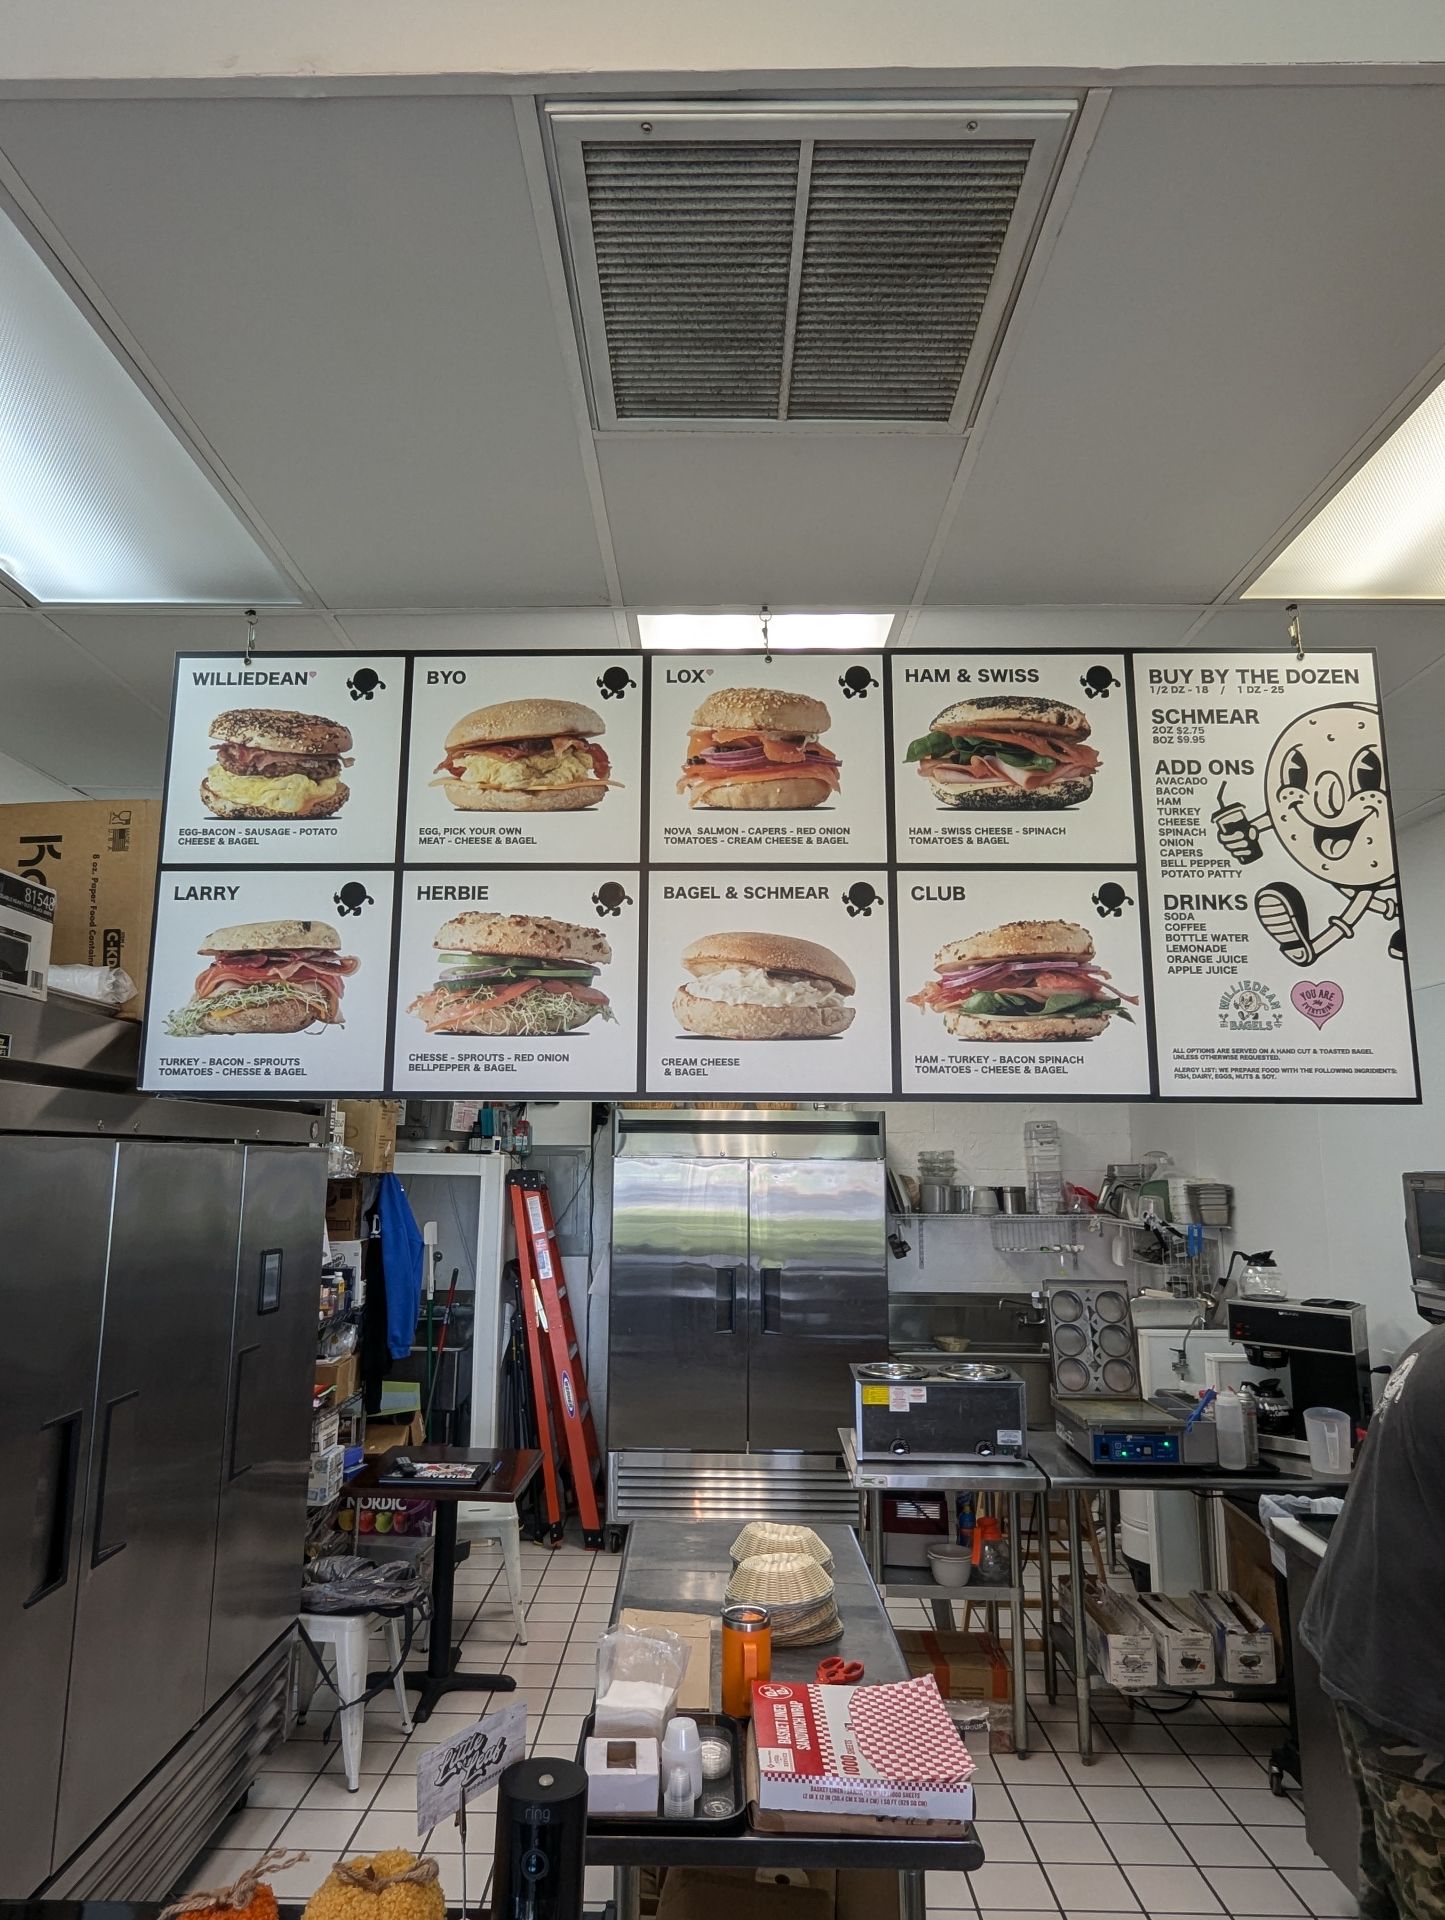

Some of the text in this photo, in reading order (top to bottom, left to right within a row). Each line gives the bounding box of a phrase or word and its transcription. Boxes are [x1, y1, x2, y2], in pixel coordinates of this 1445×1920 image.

[192, 672, 308, 686] WILLIEDEAN
[427, 670, 466, 684] BYO
[666, 669, 705, 684] LOX
[905, 668, 1040, 683] HAM & SWISS
[1148, 668, 1360, 684] BUY BY THE DOZEN
[1150, 685, 1285, 695] 1/2 DZ 18 1 DZ 25
[1151, 708, 1260, 724] SCHMEAR
[1176, 726, 1205, 735] $2.75
[1176, 736, 1205, 744] $9.95
[1155, 759, 1255, 776] ADD ONS
[1155, 776, 1208, 785] AVACADO
[1156, 786, 1194, 795] BACON
[1156, 797, 1182, 806] HAM
[1156, 807, 1201, 816] TURKEY
[1158, 818, 1200, 826] CHEESE
[244, 828, 291, 836] SAUSAGE
[299, 828, 338, 836] POTATO
[443, 827, 466, 836] PICK
[468, 827, 496, 836] YOUR
[498, 827, 522, 836] OWN
[664, 827, 851, 835] NOVA SALMON CAPERS RED ONION
[908, 827, 1066, 835] HAM SWISS CHEESE SPINACH
[1158, 828, 1207, 836] SPINACH
[178, 837, 260, 846] CHEESE BAGEL
[418, 836, 537, 845] MEAT CHEESE BAGEL
[663, 836, 849, 845] TOMATOES CREAM CHEESE BAGEL
[908, 836, 1010, 845] TOMATOES BAGEL
[1159, 838, 1194, 847] ONION
[1160, 848, 1204, 858] CAPERS
[1160, 859, 1231, 868] BELL PEPPER
[1161, 869, 1243, 878] POTATO PATTY
[90, 877, 99, 903] Paper
[174, 886, 240, 900] LARRY
[417, 886, 489, 900] HERBIE
[664, 886, 830, 899] BAGEL & SCHMEAR
[911, 886, 966, 902] CLUB
[1163, 894, 1248, 911] DRINKS
[89, 905, 98, 926] Food
[1164, 912, 1195, 921] SODA
[1164, 922, 1207, 932] COFFEE
[1165, 934, 1249, 942] BOTTLE WATER
[1166, 944, 1228, 953] LEMONADE
[1166, 954, 1248, 964] ORANGE JUICE
[1167, 966, 1238, 975] APPLE JUICE
[1300, 989, 1335, 1002] YOU ARE
[1229, 1020, 1274, 1031] BAGELS
[159, 1058, 300, 1066] TURKEY BACON SPROUTS
[408, 1053, 570, 1062] CHESSE SPROUTS RED ONION
[661, 1058, 740, 1066] CREAM CHEESE
[914, 1055, 1084, 1064] HAM TURKEY BACON SPINACH
[158, 1068, 308, 1076] TOMATOES CHESSE BAGEL
[408, 1063, 517, 1072] BELLPEPPER BAGEL
[674, 1068, 709, 1076] BAGEL
[914, 1065, 1069, 1074] TOMATOES CHEESE BAGEL
[773, 1703, 788, 1720] LINER
[790, 1700, 812, 1750] SANDWICH WRAP
[775, 1721, 792, 1745] BASKET
[841, 1754, 861, 1776] 1000
[525, 1806, 551, 1824] ring
